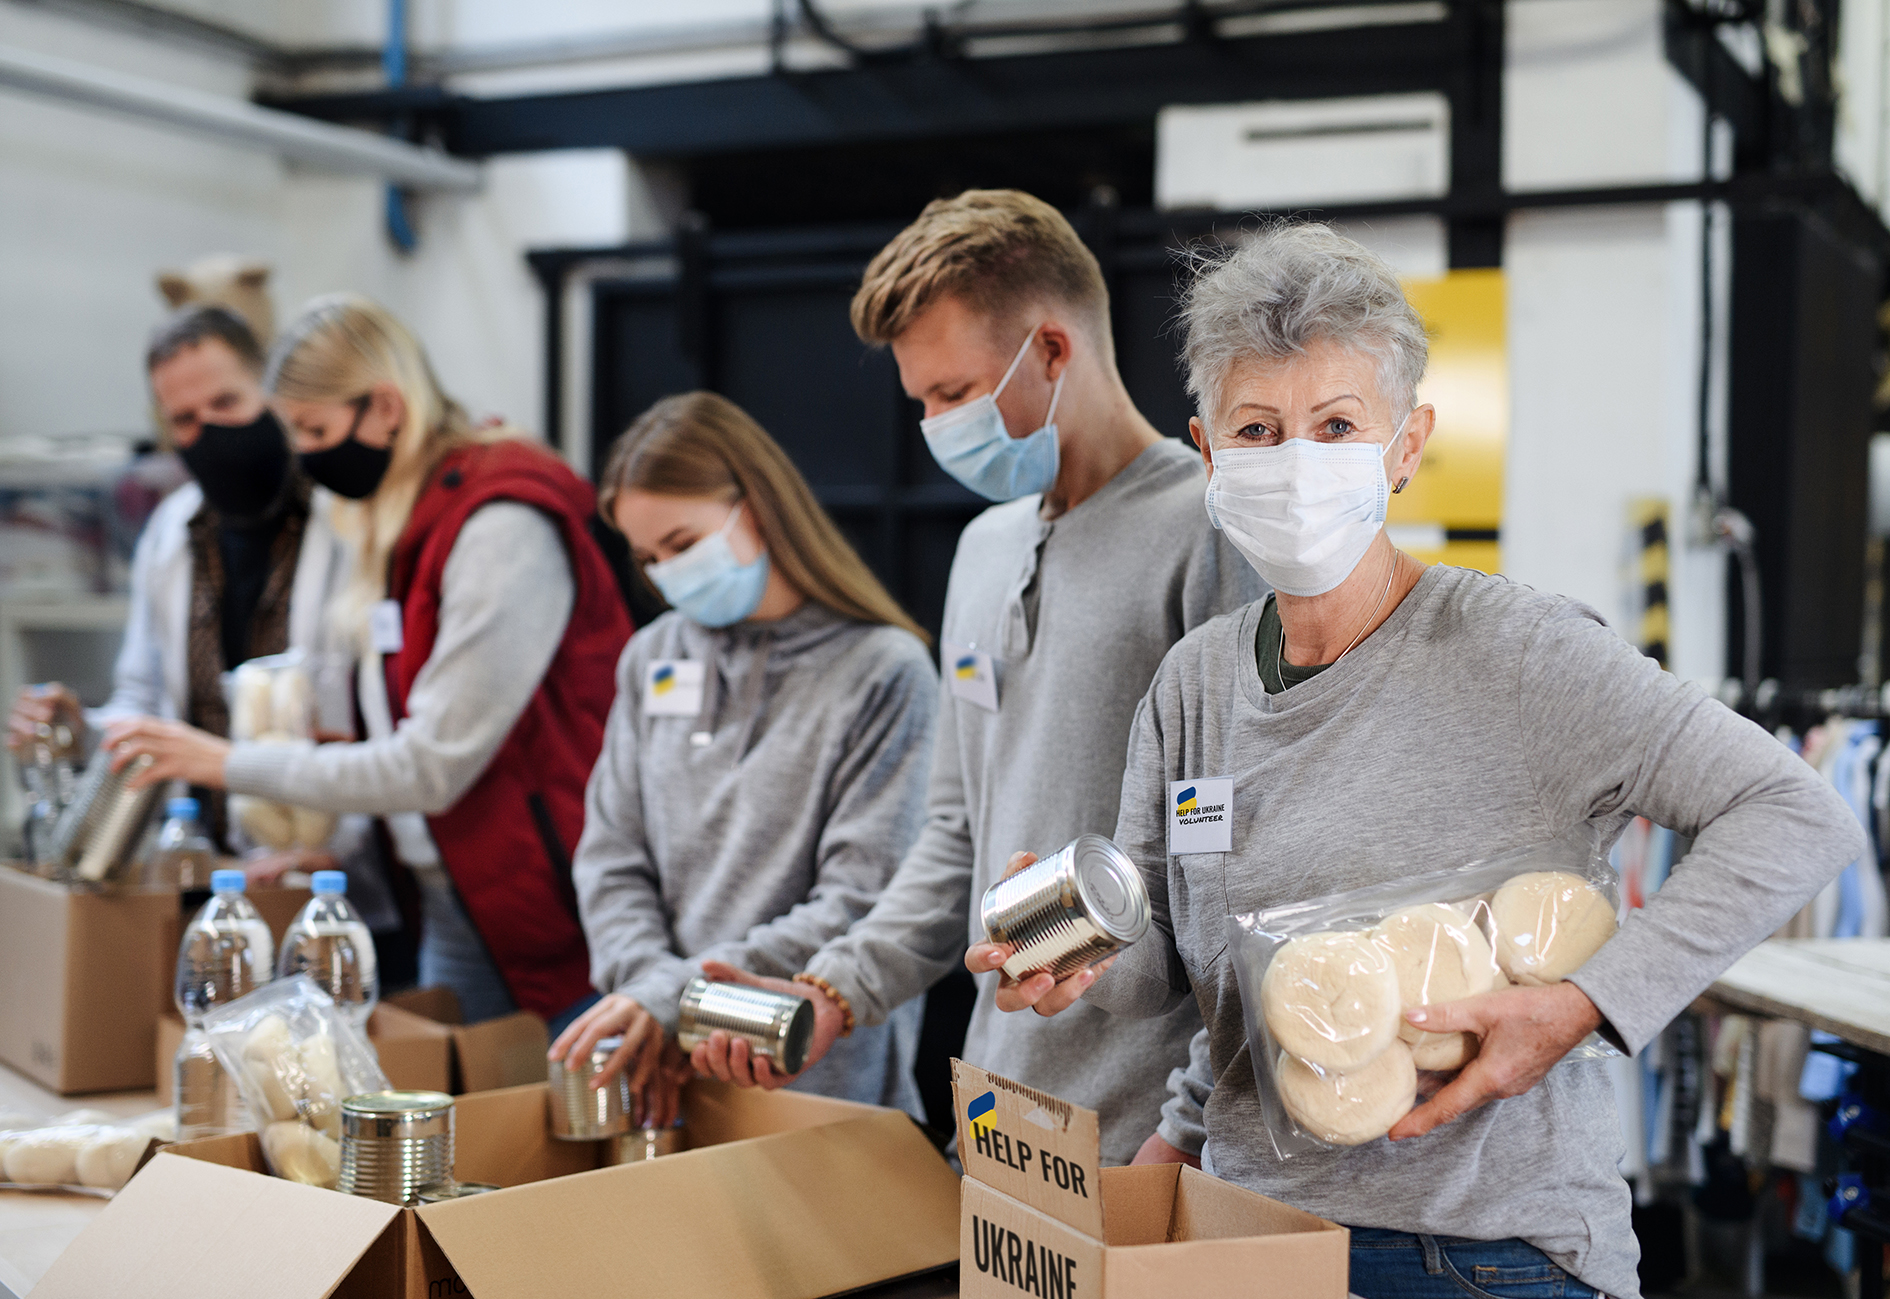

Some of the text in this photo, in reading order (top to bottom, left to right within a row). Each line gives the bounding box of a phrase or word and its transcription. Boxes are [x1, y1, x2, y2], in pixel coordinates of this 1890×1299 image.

[1176, 804, 1225, 817] HELP FOR UKRAINE
[1179, 815, 1223, 825] VOLUNTEER
[973, 1121, 1088, 1199] HELP FOR
[973, 1214, 1076, 1299] UKRAINE
